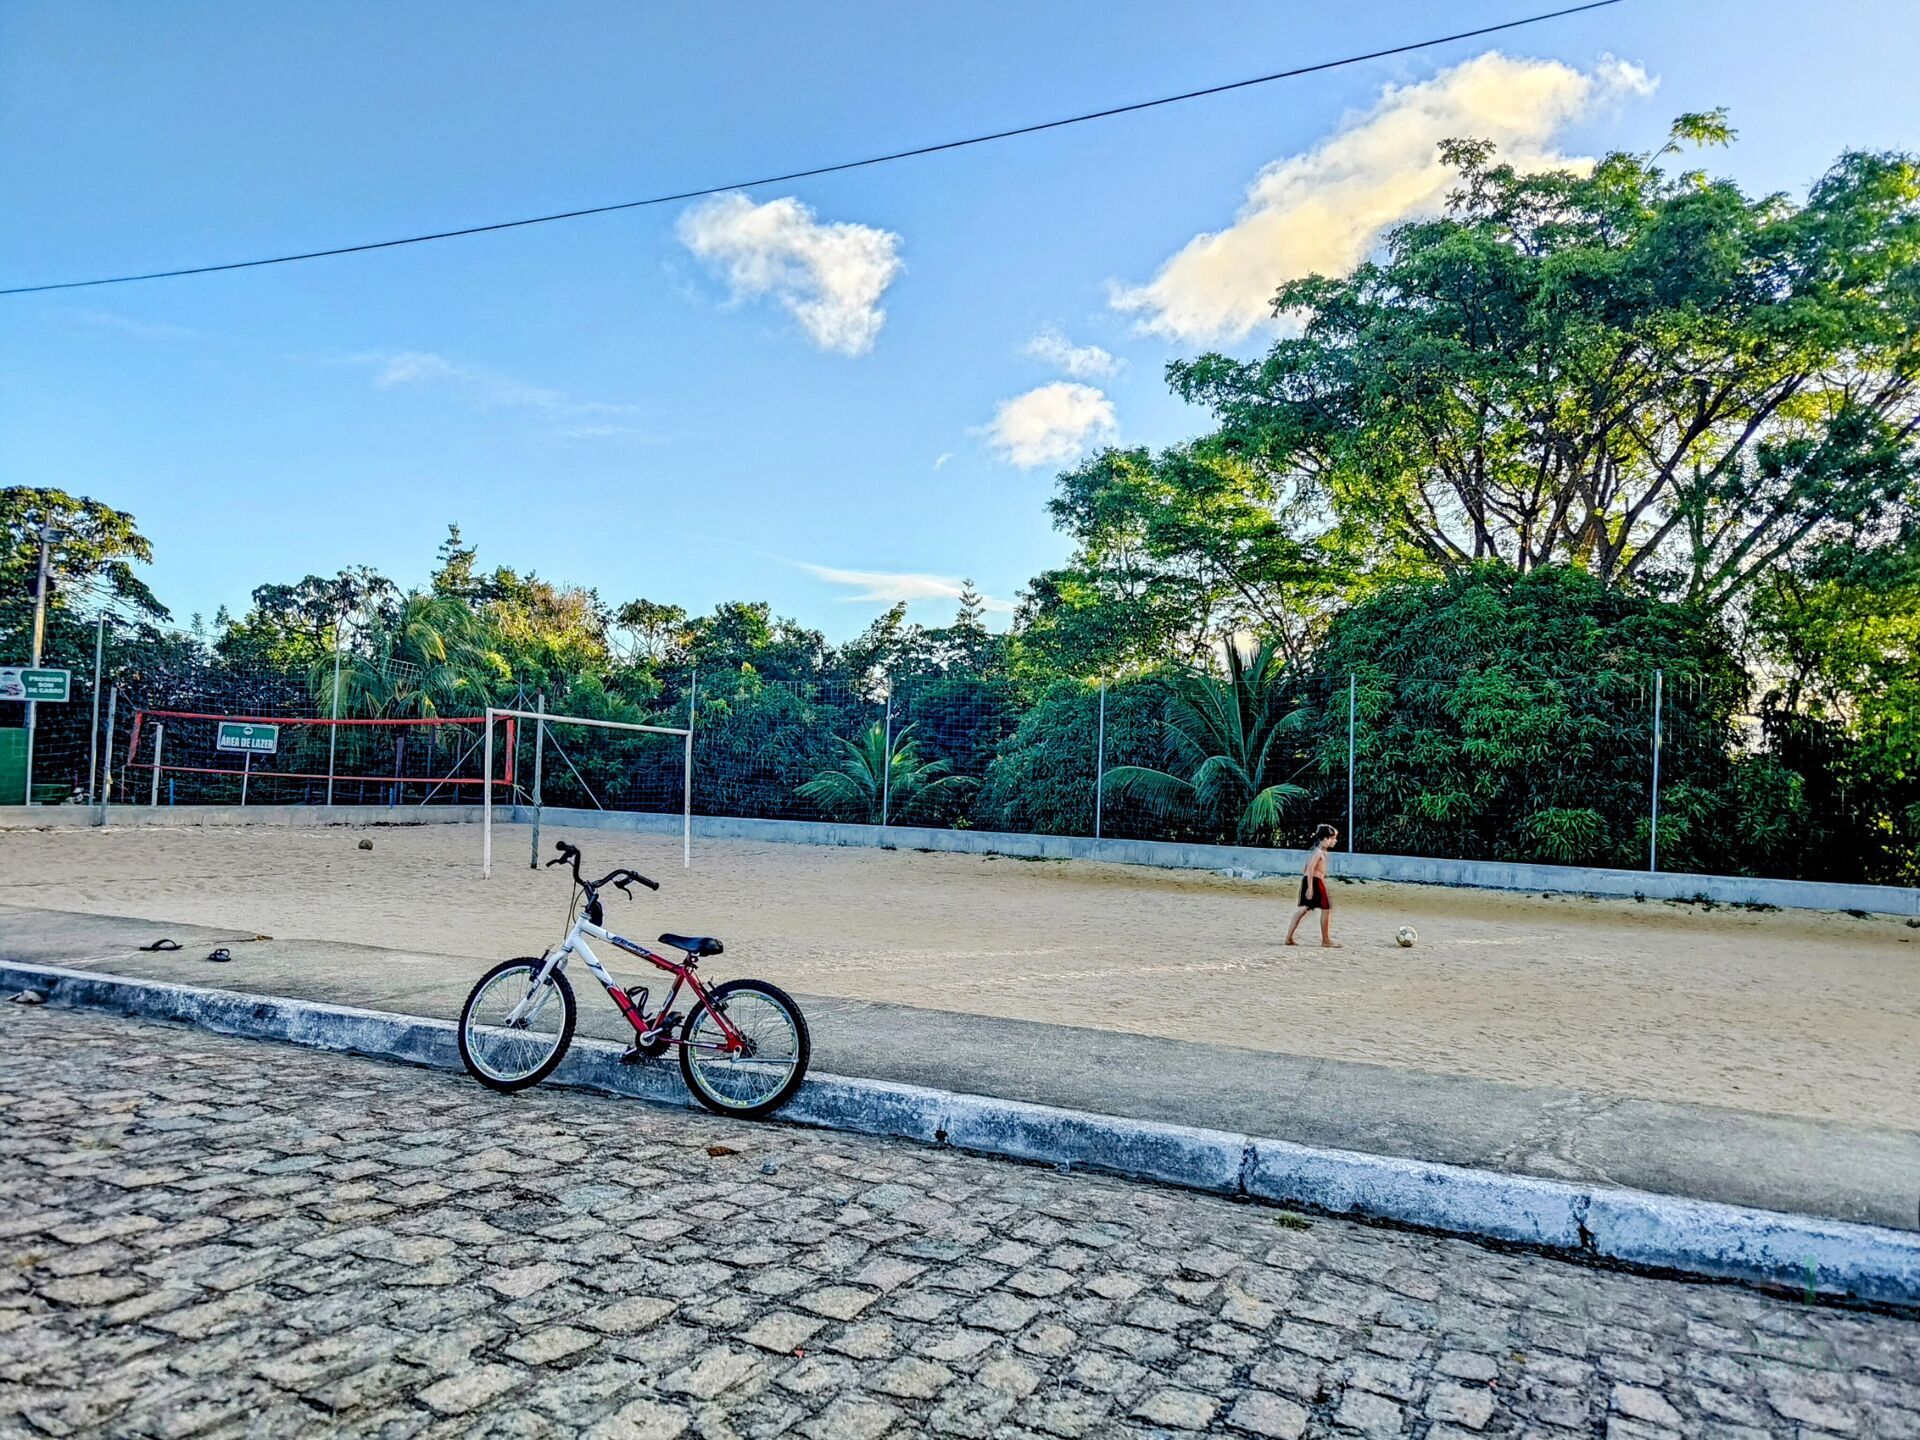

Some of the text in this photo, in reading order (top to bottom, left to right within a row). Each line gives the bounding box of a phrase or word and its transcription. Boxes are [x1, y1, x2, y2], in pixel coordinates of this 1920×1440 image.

[220, 734, 274, 749] ÁREA DE LAZER
